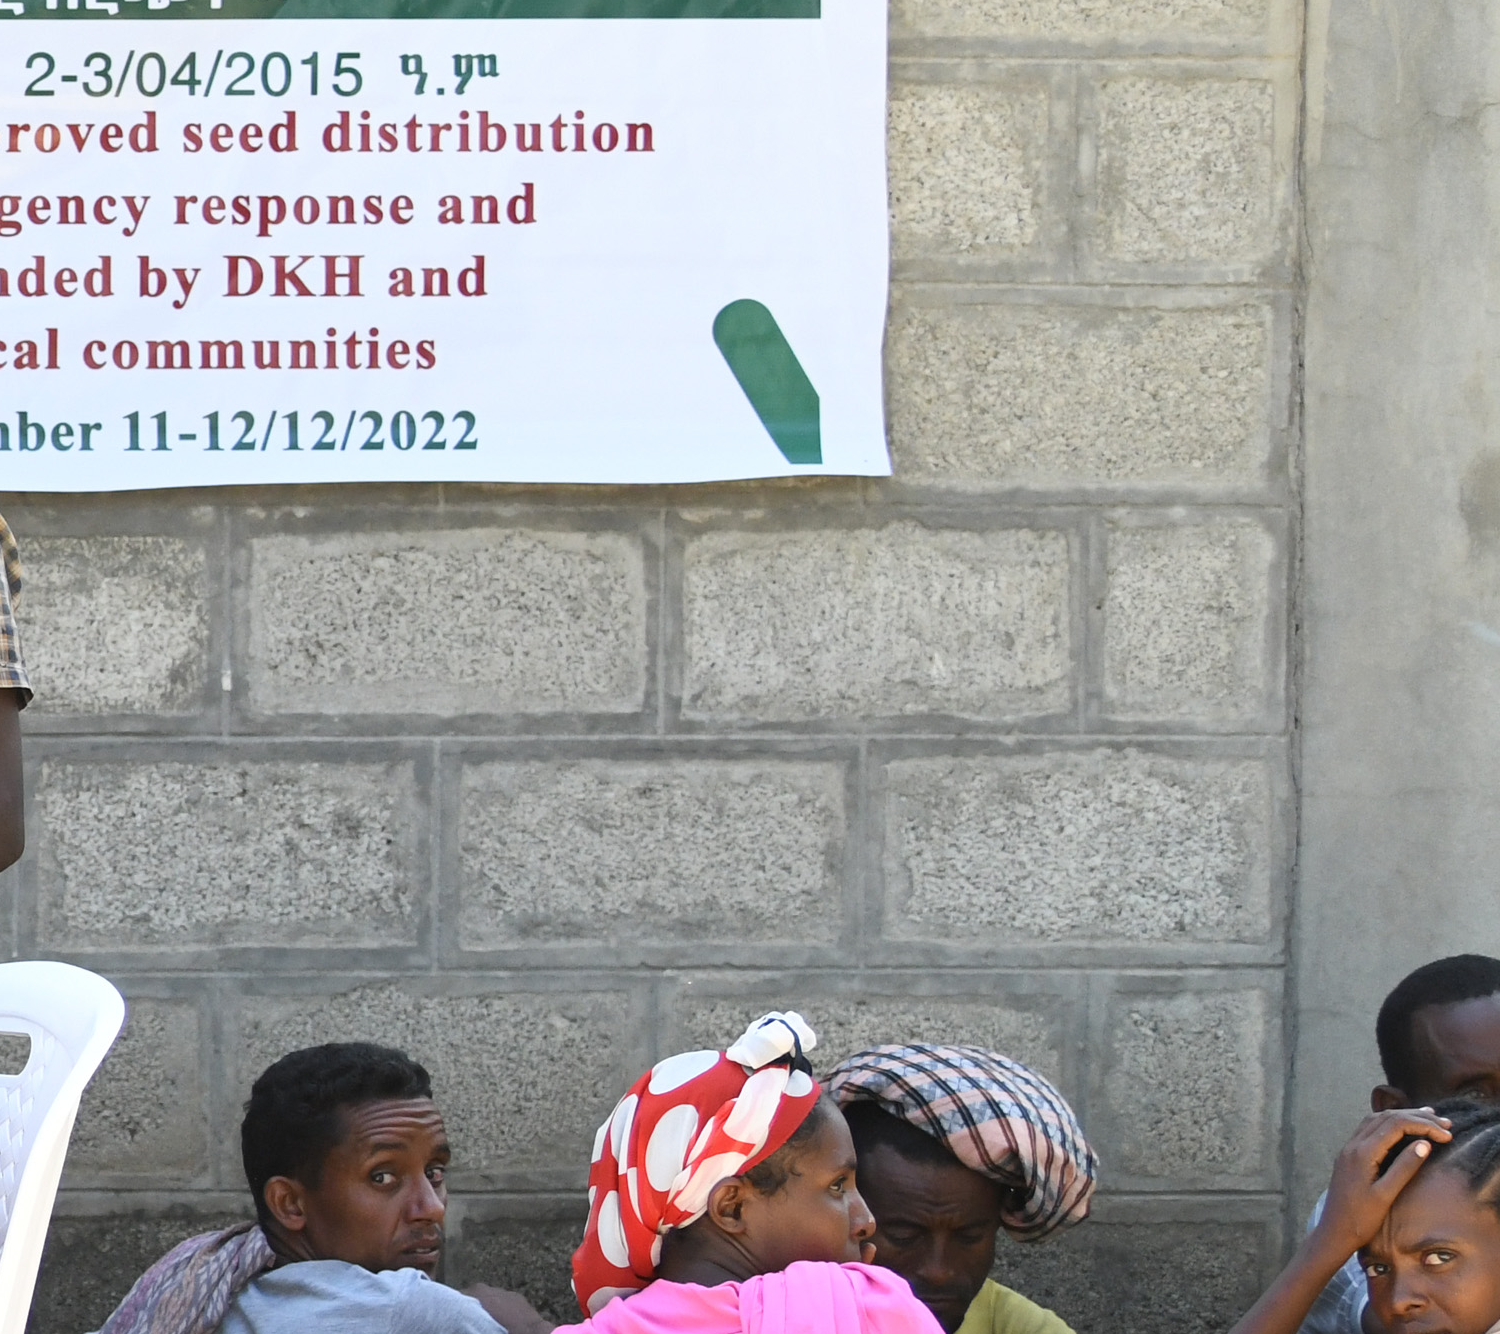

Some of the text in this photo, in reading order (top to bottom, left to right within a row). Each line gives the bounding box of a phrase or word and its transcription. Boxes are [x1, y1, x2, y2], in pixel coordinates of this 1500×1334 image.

[24, 49, 363, 98] 2-3/04/2015
[399, 53, 500, 96] ዓ.ም
[183, 110, 299, 153] seed
[321, 109, 655, 153] distribution
[173, 194, 415, 238] response
[437, 182, 537, 225] and
[137, 255, 202, 310] by
[222, 254, 365, 297] DKH
[388, 254, 488, 298] and
[82, 326, 436, 370] communities
[122, 409, 479, 453] 11-12/12/2022
